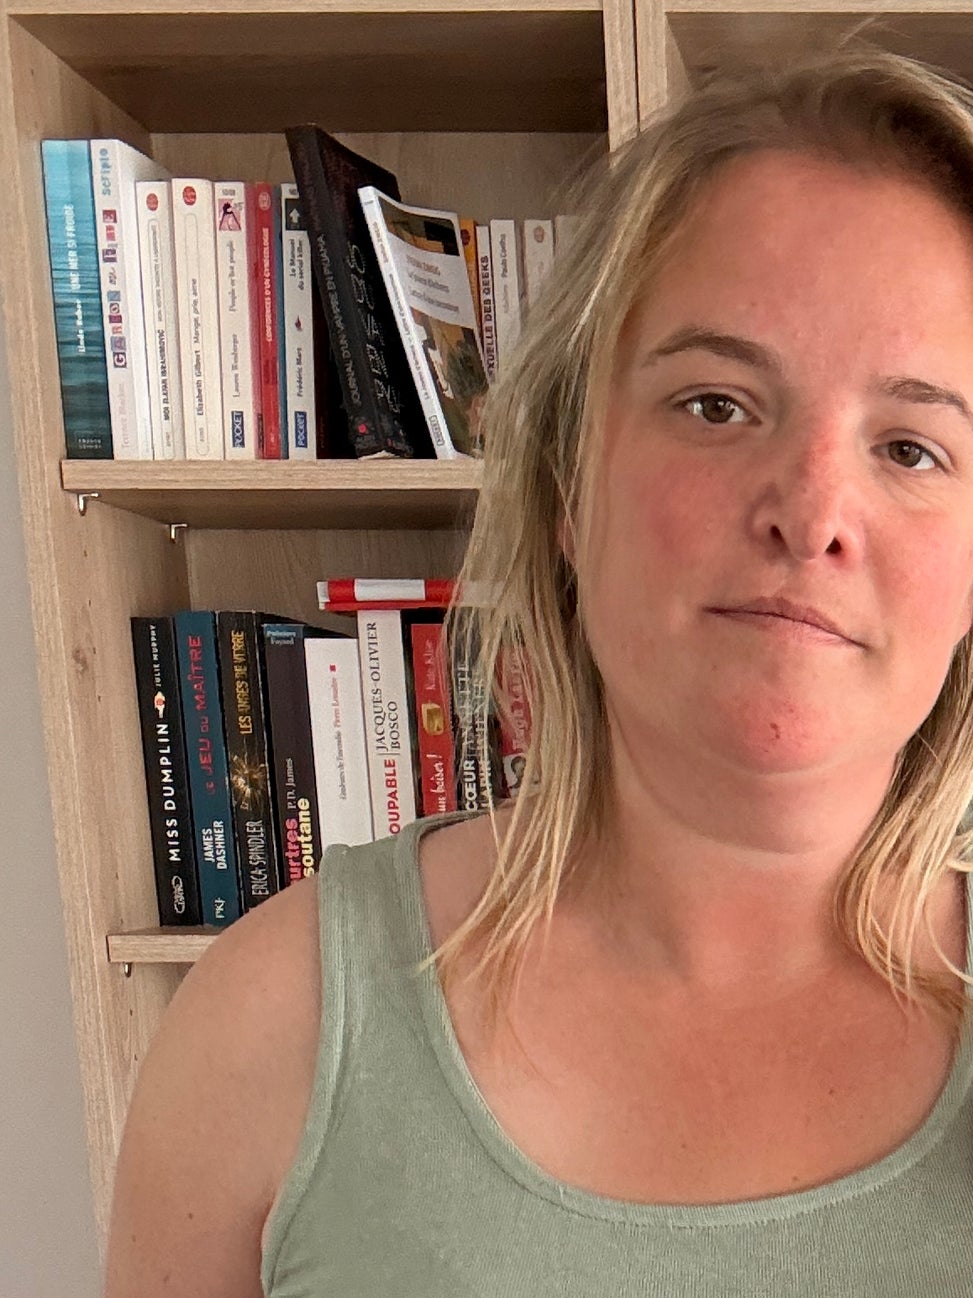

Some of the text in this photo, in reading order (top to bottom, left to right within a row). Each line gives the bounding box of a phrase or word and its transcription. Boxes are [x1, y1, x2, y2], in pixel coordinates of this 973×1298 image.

[483, 300, 492, 322] DES
[153, 663, 162, 687] JULIE
[186, 635, 207, 711] MAÎTRE
[366, 622, 401, 835] OUPABLE JACQUES-OLIVIER
[387, 701, 401, 750] BOSCO
[156, 723, 177, 811] DUMPLIN
[199, 738, 214, 774] JEU
[284, 758, 296, 787] James
[165, 818, 181, 862] MISS
[202, 828, 215, 863] JAMES
[213, 820, 228, 870] DASHNER
[246, 820, 267, 866] SPINDLER
[296, 798, 316, 878] soutane
[252, 868, 269, 896] ERICA
